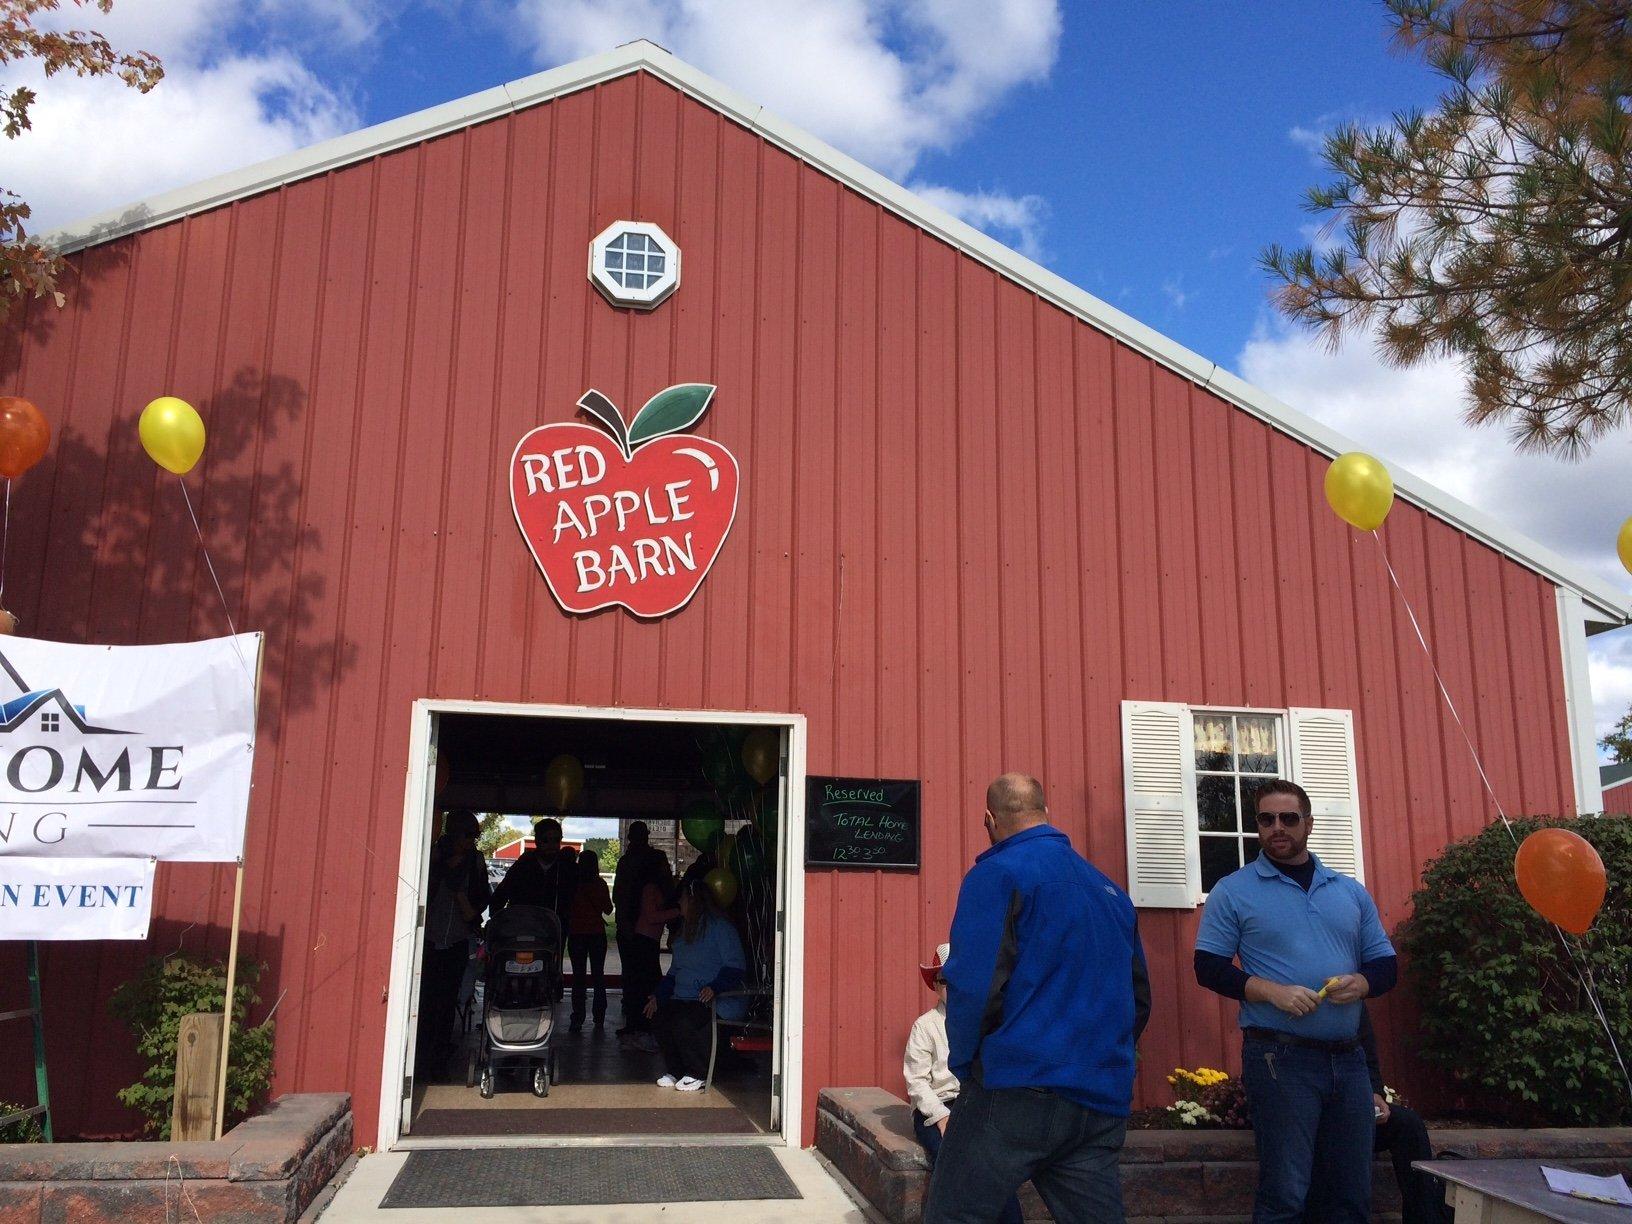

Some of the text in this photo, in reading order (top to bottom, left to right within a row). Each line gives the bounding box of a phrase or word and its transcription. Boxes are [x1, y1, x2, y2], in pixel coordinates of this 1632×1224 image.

[520, 444, 606, 496] RED
[552, 479, 695, 544] APPLE
[572, 532, 697, 593] BARN
[0, 745, 184, 793] OME
[825, 784, 884, 801] Reserved
[854, 828, 904, 843] LENDING
[32, 884, 143, 908] EVENT
